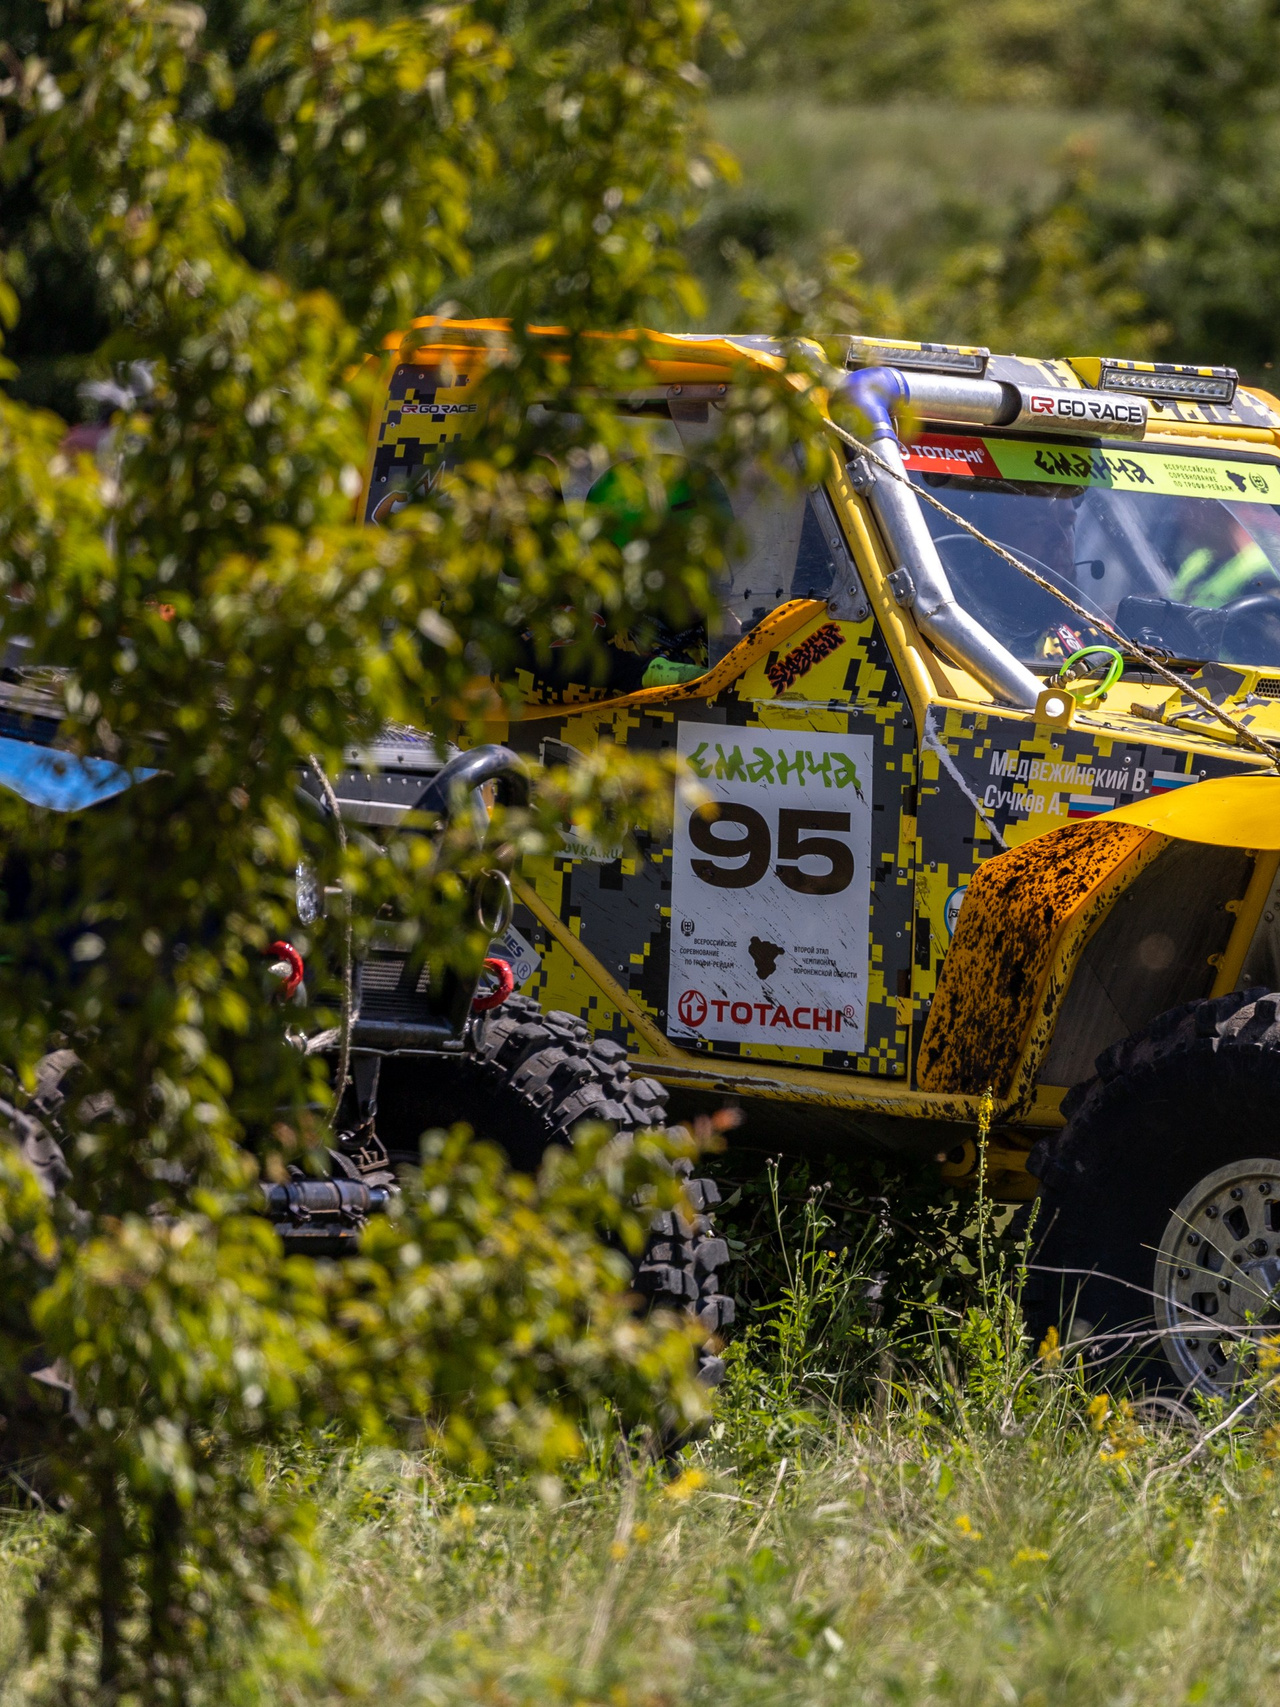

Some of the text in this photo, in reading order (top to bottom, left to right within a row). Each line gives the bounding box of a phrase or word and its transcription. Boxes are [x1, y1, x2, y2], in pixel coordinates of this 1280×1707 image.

[441, 403, 477, 413] RACE
[1087, 401, 1143, 424] RACE
[1162, 463, 1218, 475] ВСЕРОССИЙСКОЕ
[1167, 471, 1219, 483] СОРЕВНОВАНИЕ
[688, 801, 855, 896] 95
[693, 938, 738, 948] ВСЕРОССИЙСКОЕ
[679, 948, 720, 957] СОРЕВНОВАНИЕ
[793, 945, 829, 955] ВТОРОЙ ЭТАП
[793, 967, 833, 977] ВОРОНЕЖСКОЙ
